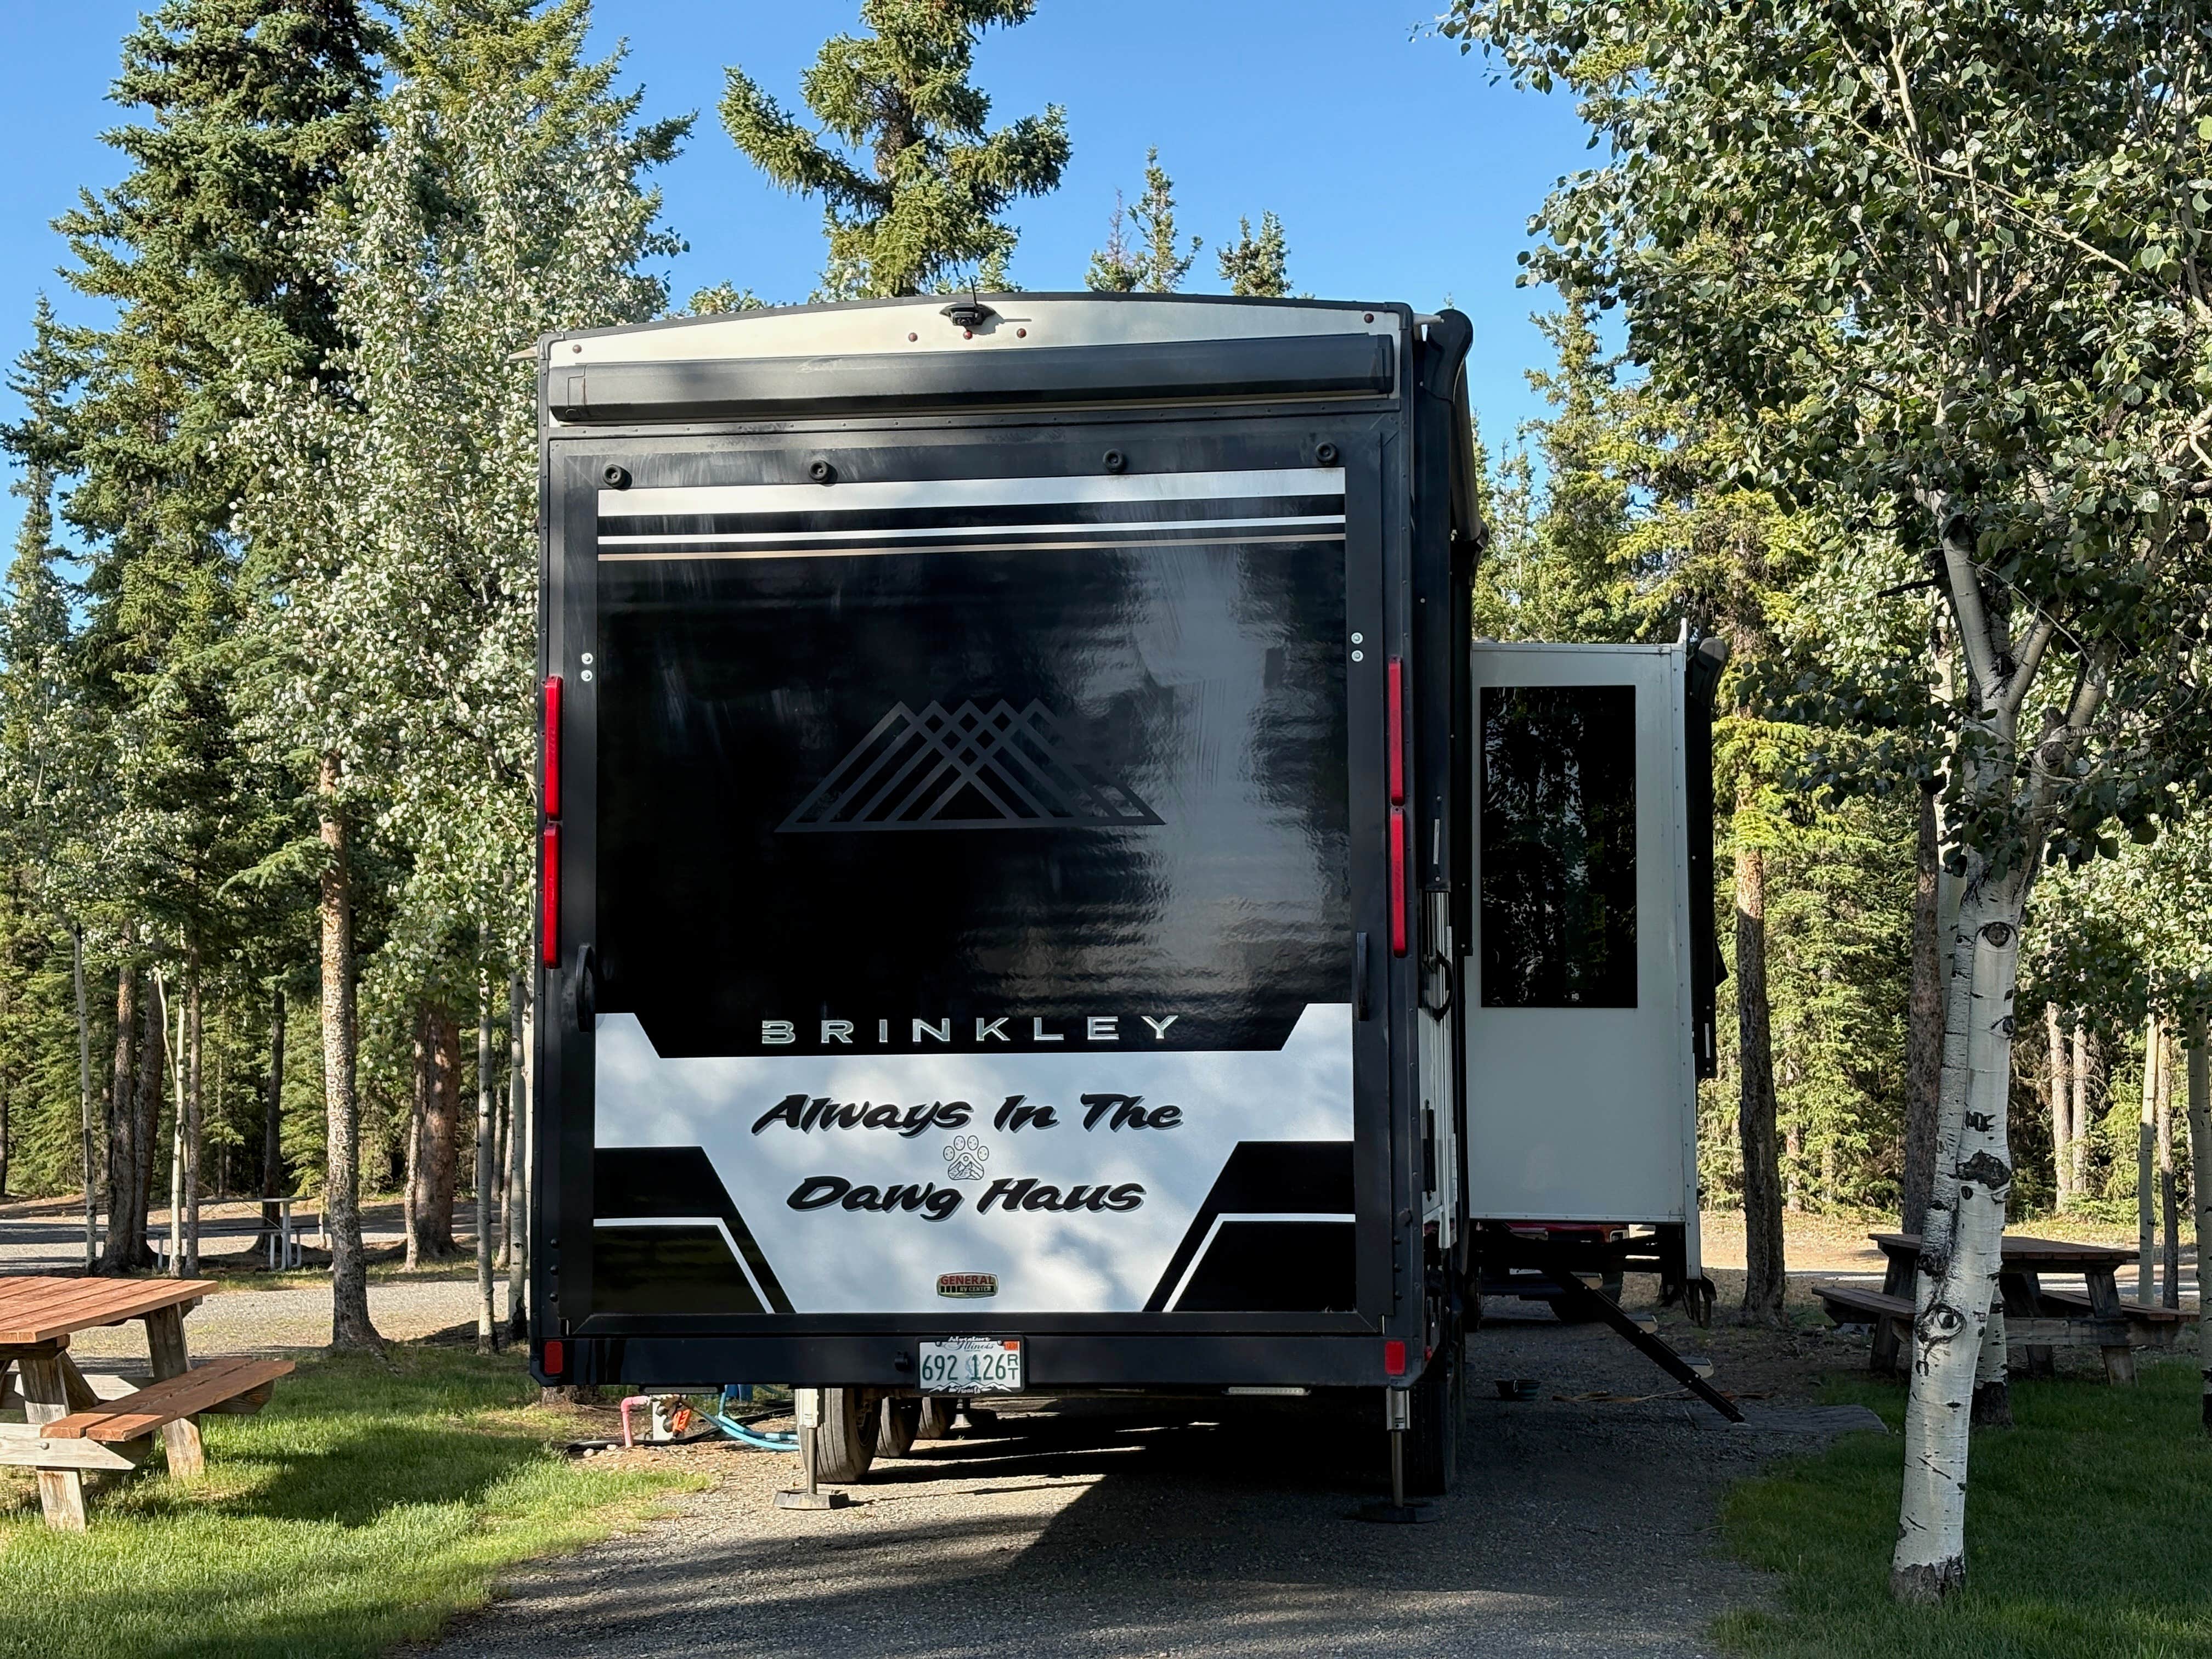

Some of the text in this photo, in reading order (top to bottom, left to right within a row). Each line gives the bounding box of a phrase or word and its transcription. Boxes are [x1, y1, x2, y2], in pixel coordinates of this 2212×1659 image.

[761, 1015, 1178, 1044] BRINKLEY
[751, 1093, 1183, 1139] Always In The
[786, 1175, 1147, 1222] Dawg Haus
[940, 1276, 995, 1285] GENERAL
[922, 1355, 958, 1381] 692
[970, 1354, 1006, 1380] 126
